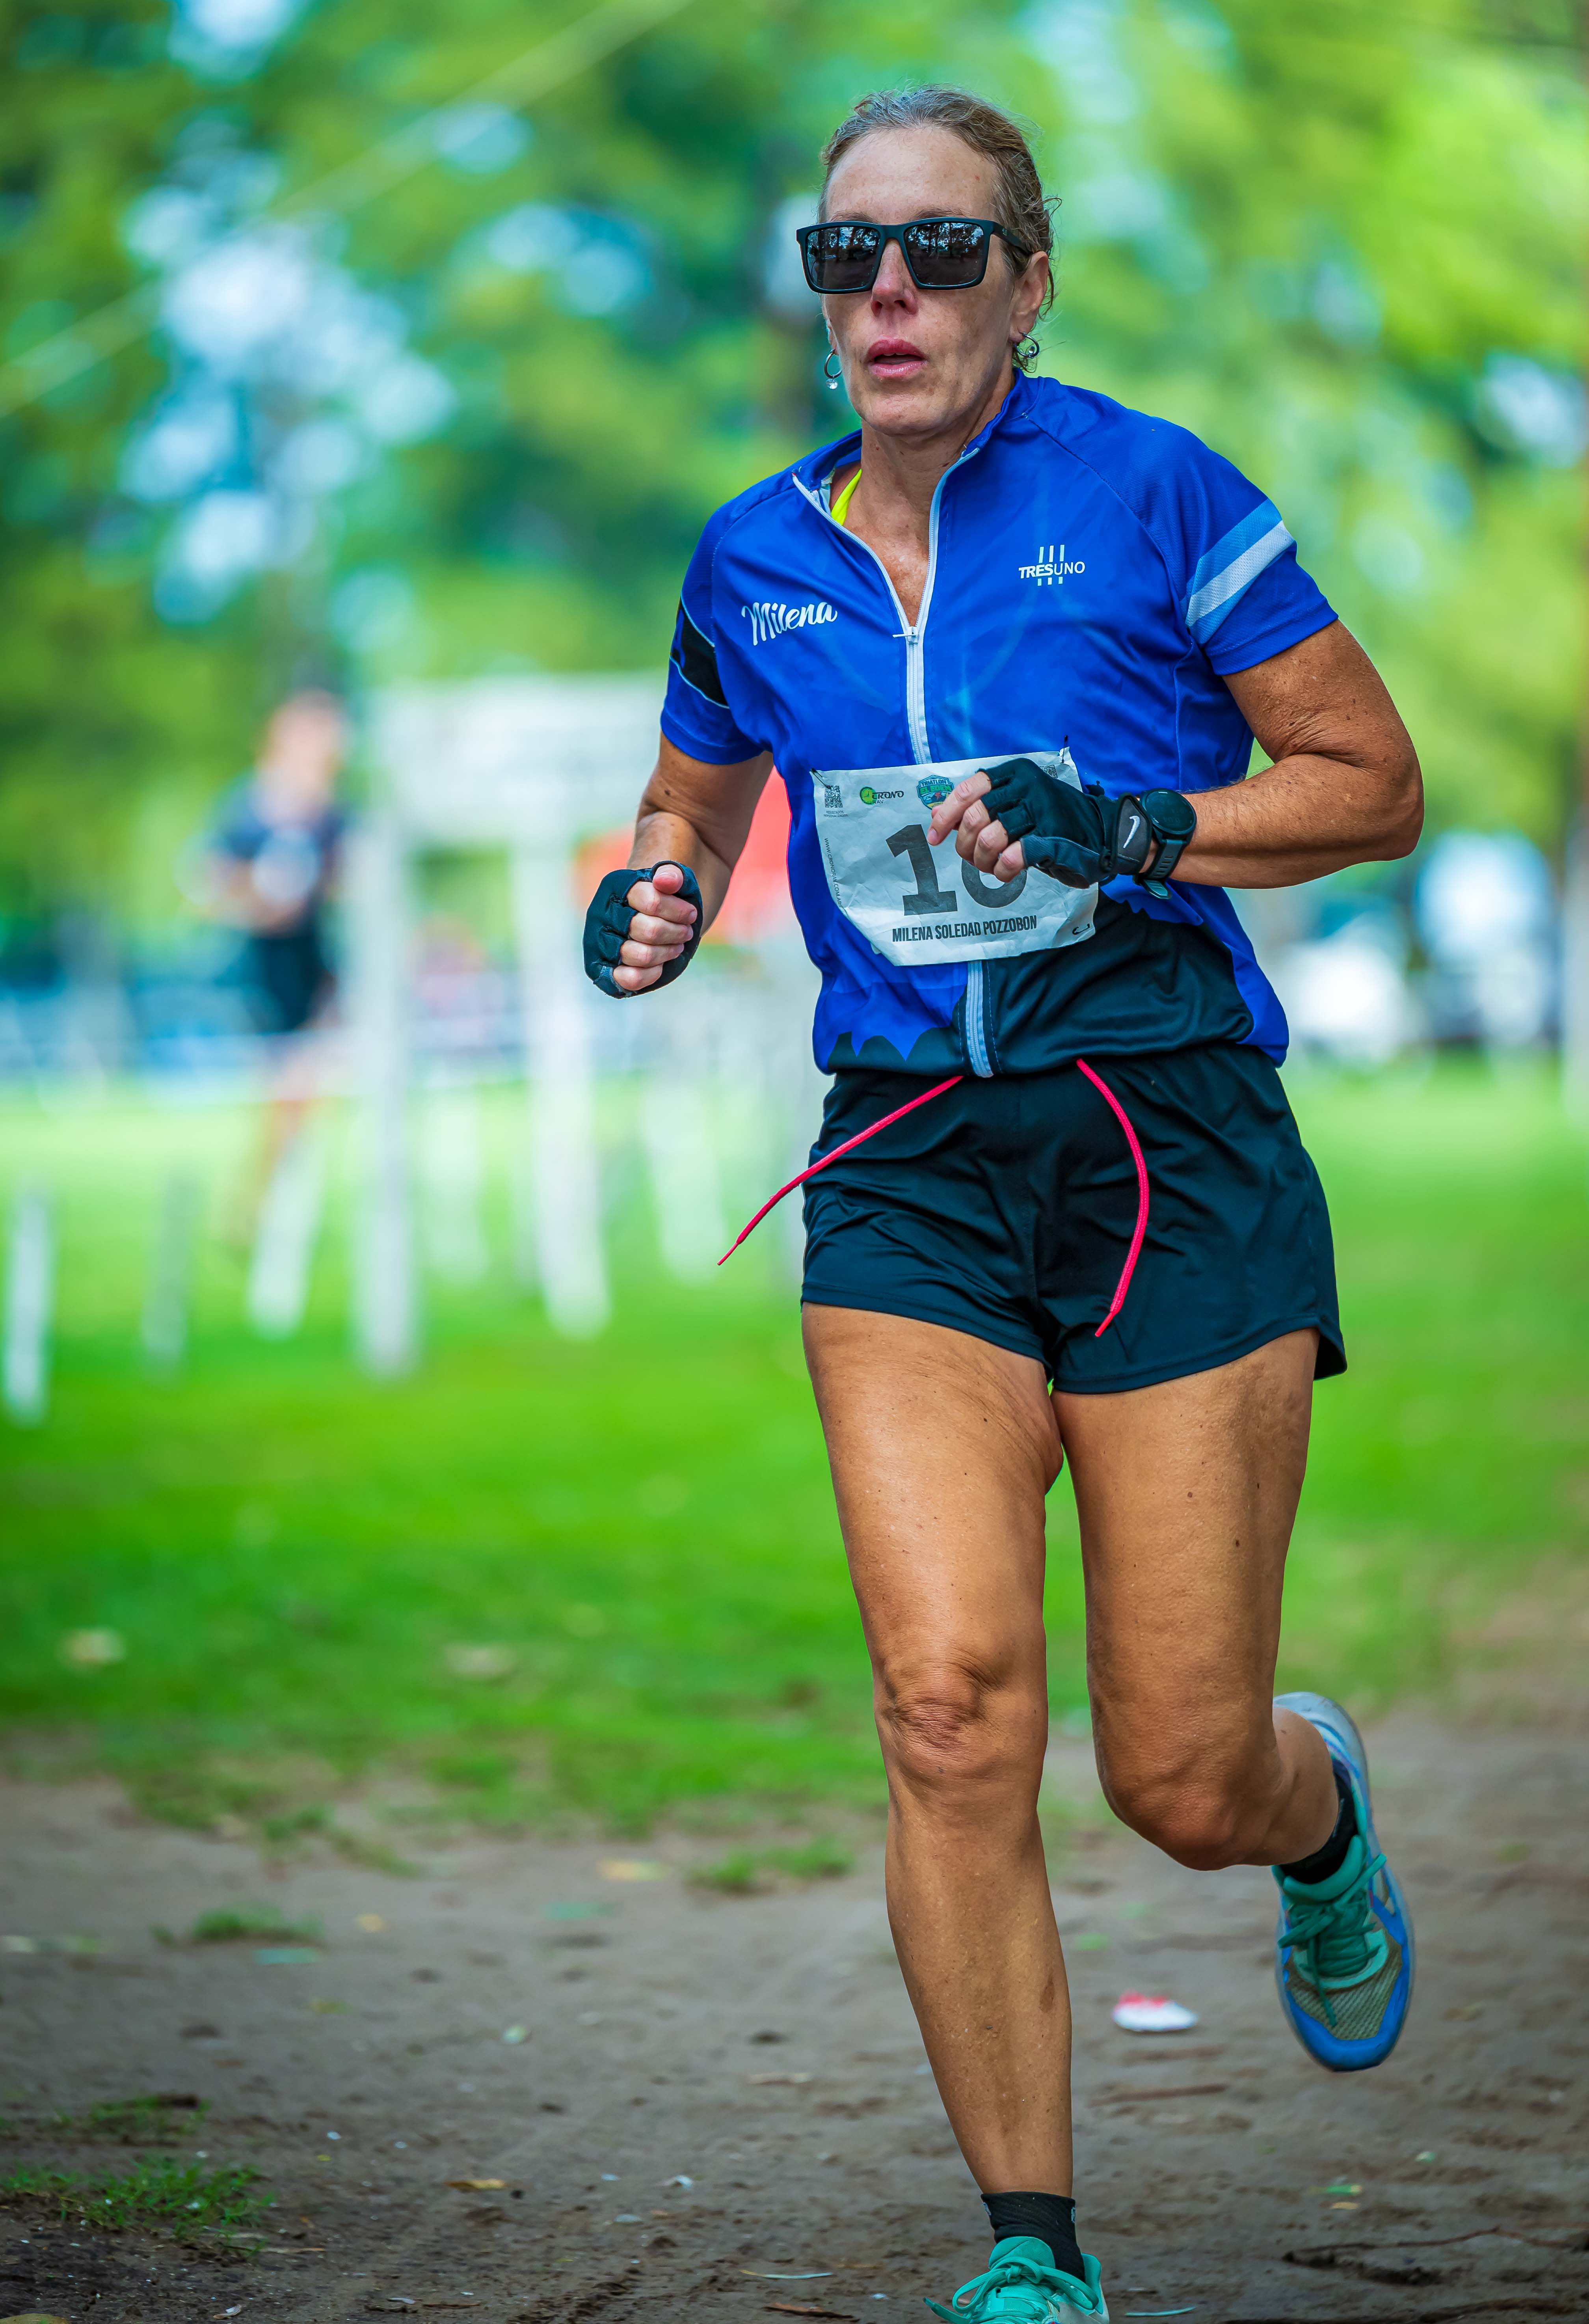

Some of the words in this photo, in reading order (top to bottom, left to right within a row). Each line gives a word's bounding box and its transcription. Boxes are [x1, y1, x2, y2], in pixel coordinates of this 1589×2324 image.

[1018, 561, 1085, 579] TRESUNO
[741, 602, 837, 646] Milena
[892, 926, 933, 942] MILENA
[935, 922, 981, 939] SOLEDAD
[984, 915, 1037, 935] POZZOBON
